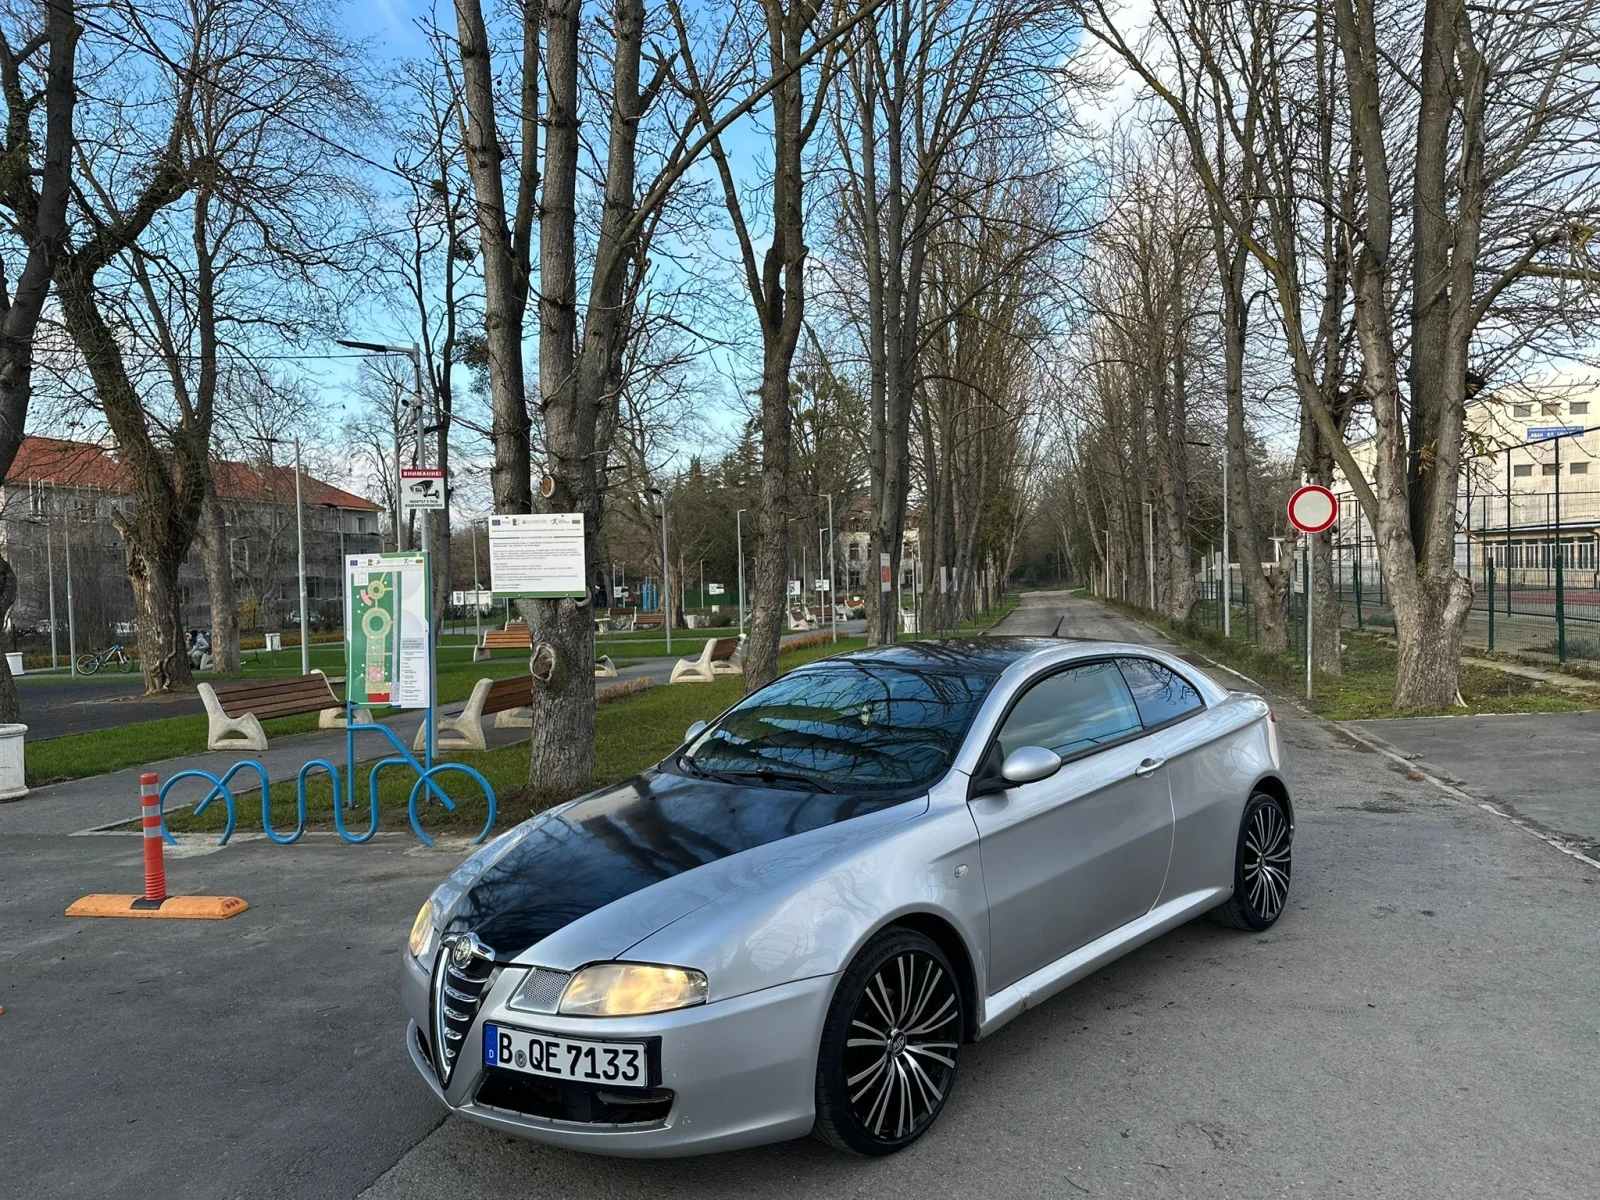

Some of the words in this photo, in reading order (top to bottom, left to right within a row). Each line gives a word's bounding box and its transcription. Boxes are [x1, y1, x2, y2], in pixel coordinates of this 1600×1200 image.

[488, 1049, 494, 1059] D
[499, 1032, 513, 1064] B
[528, 1038, 562, 1074] QE
[566, 1044, 639, 1082] 7133
